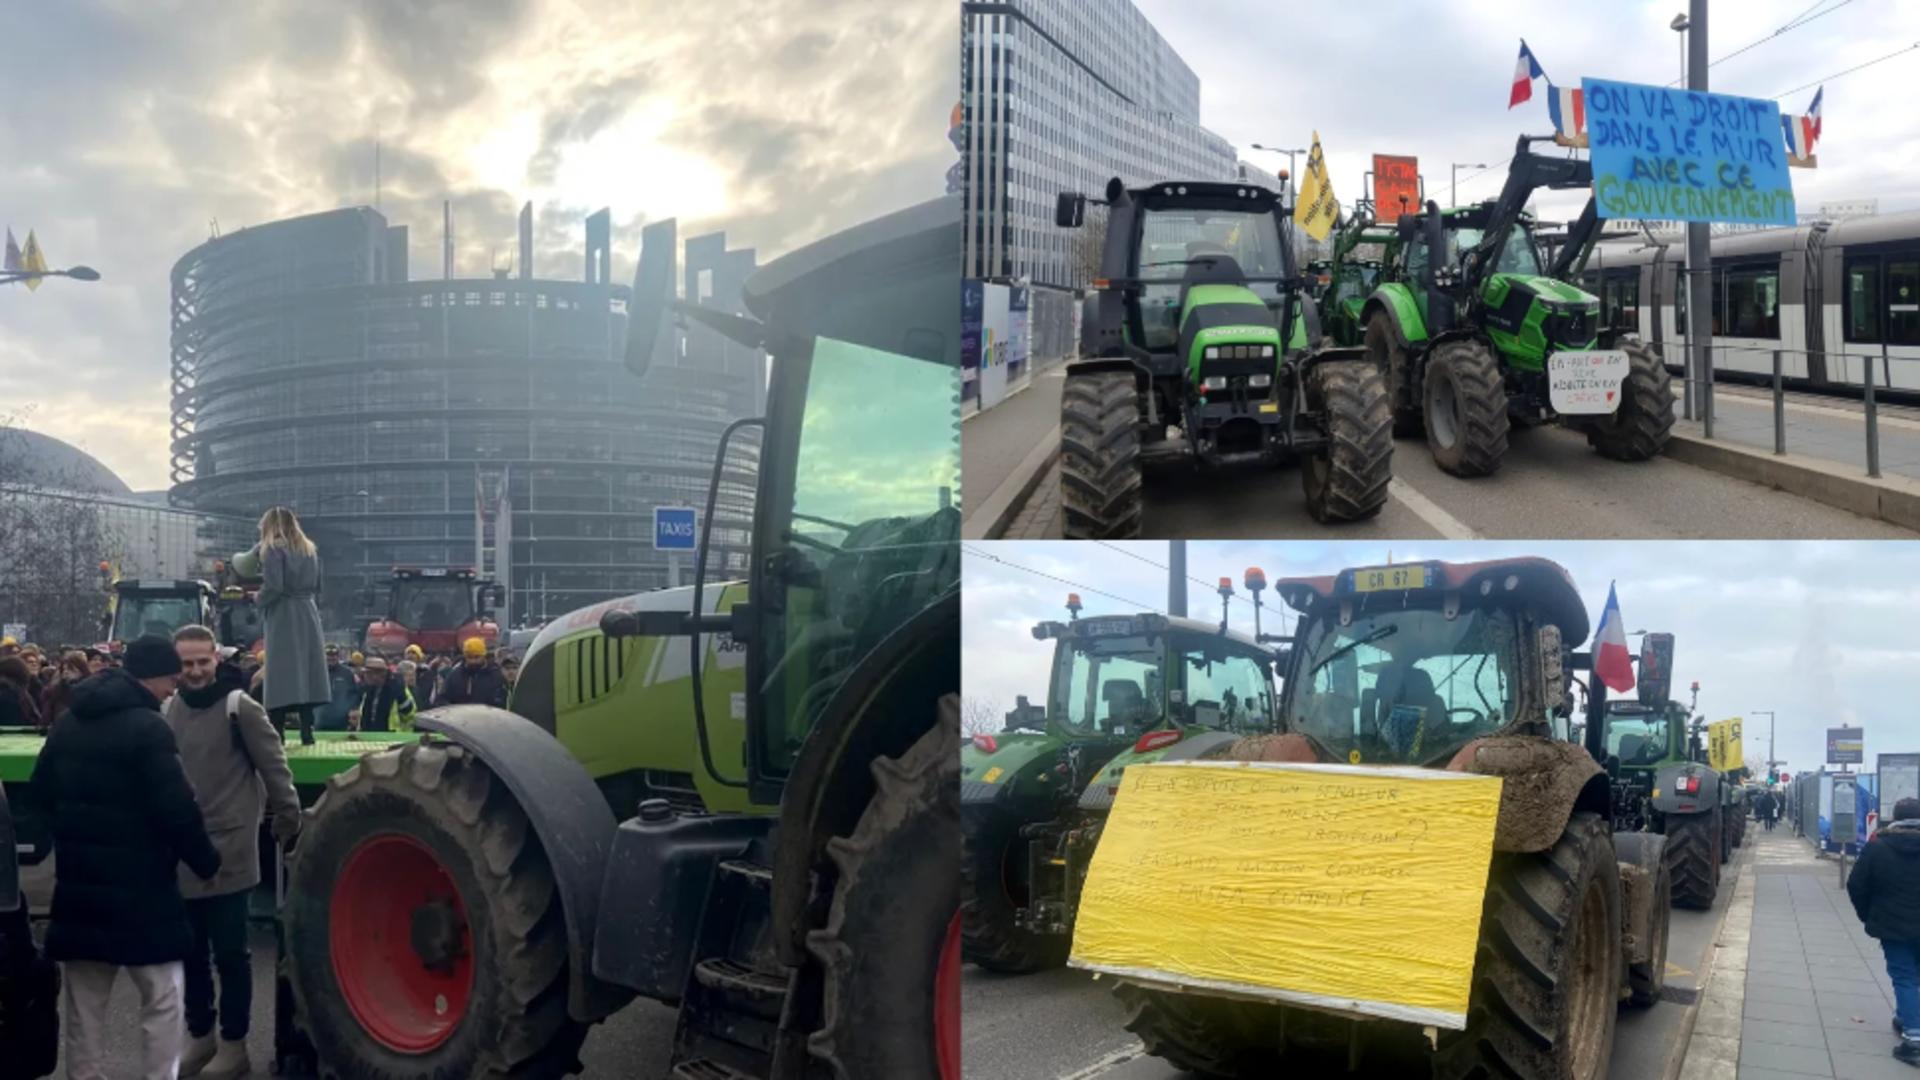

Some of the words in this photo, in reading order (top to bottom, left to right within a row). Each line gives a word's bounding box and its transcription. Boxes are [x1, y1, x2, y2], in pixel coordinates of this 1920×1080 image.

[1590, 86, 1629, 115] ON
[1641, 89, 1679, 122] VA
[1686, 92, 1768, 133] DROIT
[1595, 119, 1660, 154] DANS
[1672, 127, 1699, 156] LE
[1711, 131, 1777, 170] MUR
[1629, 155, 1705, 189] AVEC
[1717, 160, 1756, 190] CE
[1599, 172, 1794, 221] GOUVERNEMENT
[660, 522, 693, 537] TAXIS
[1369, 573, 1385, 588] CR
[1393, 570, 1408, 586] 67
